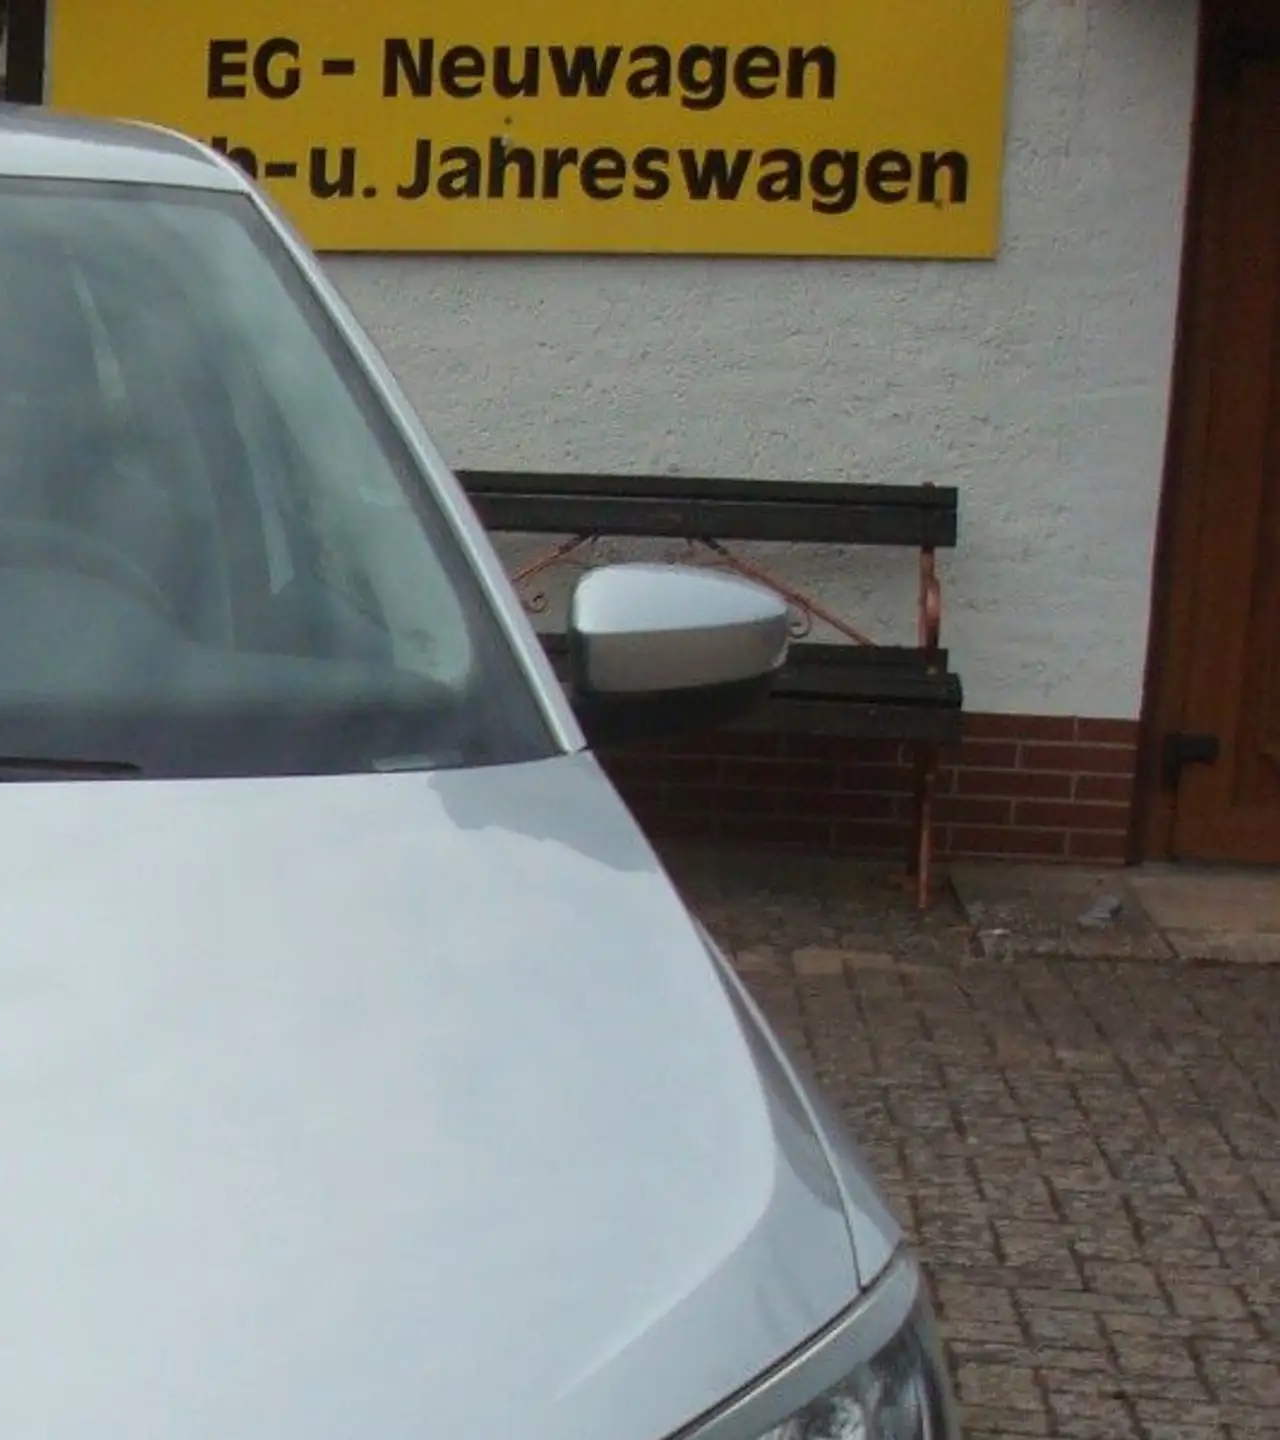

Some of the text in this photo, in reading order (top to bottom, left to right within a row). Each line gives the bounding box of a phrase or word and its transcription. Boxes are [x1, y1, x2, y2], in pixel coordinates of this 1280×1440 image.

[206, 37, 301, 100] EG
[382, 37, 837, 112] Neuwagen
[396, 136, 970, 215] Jahreswagen
